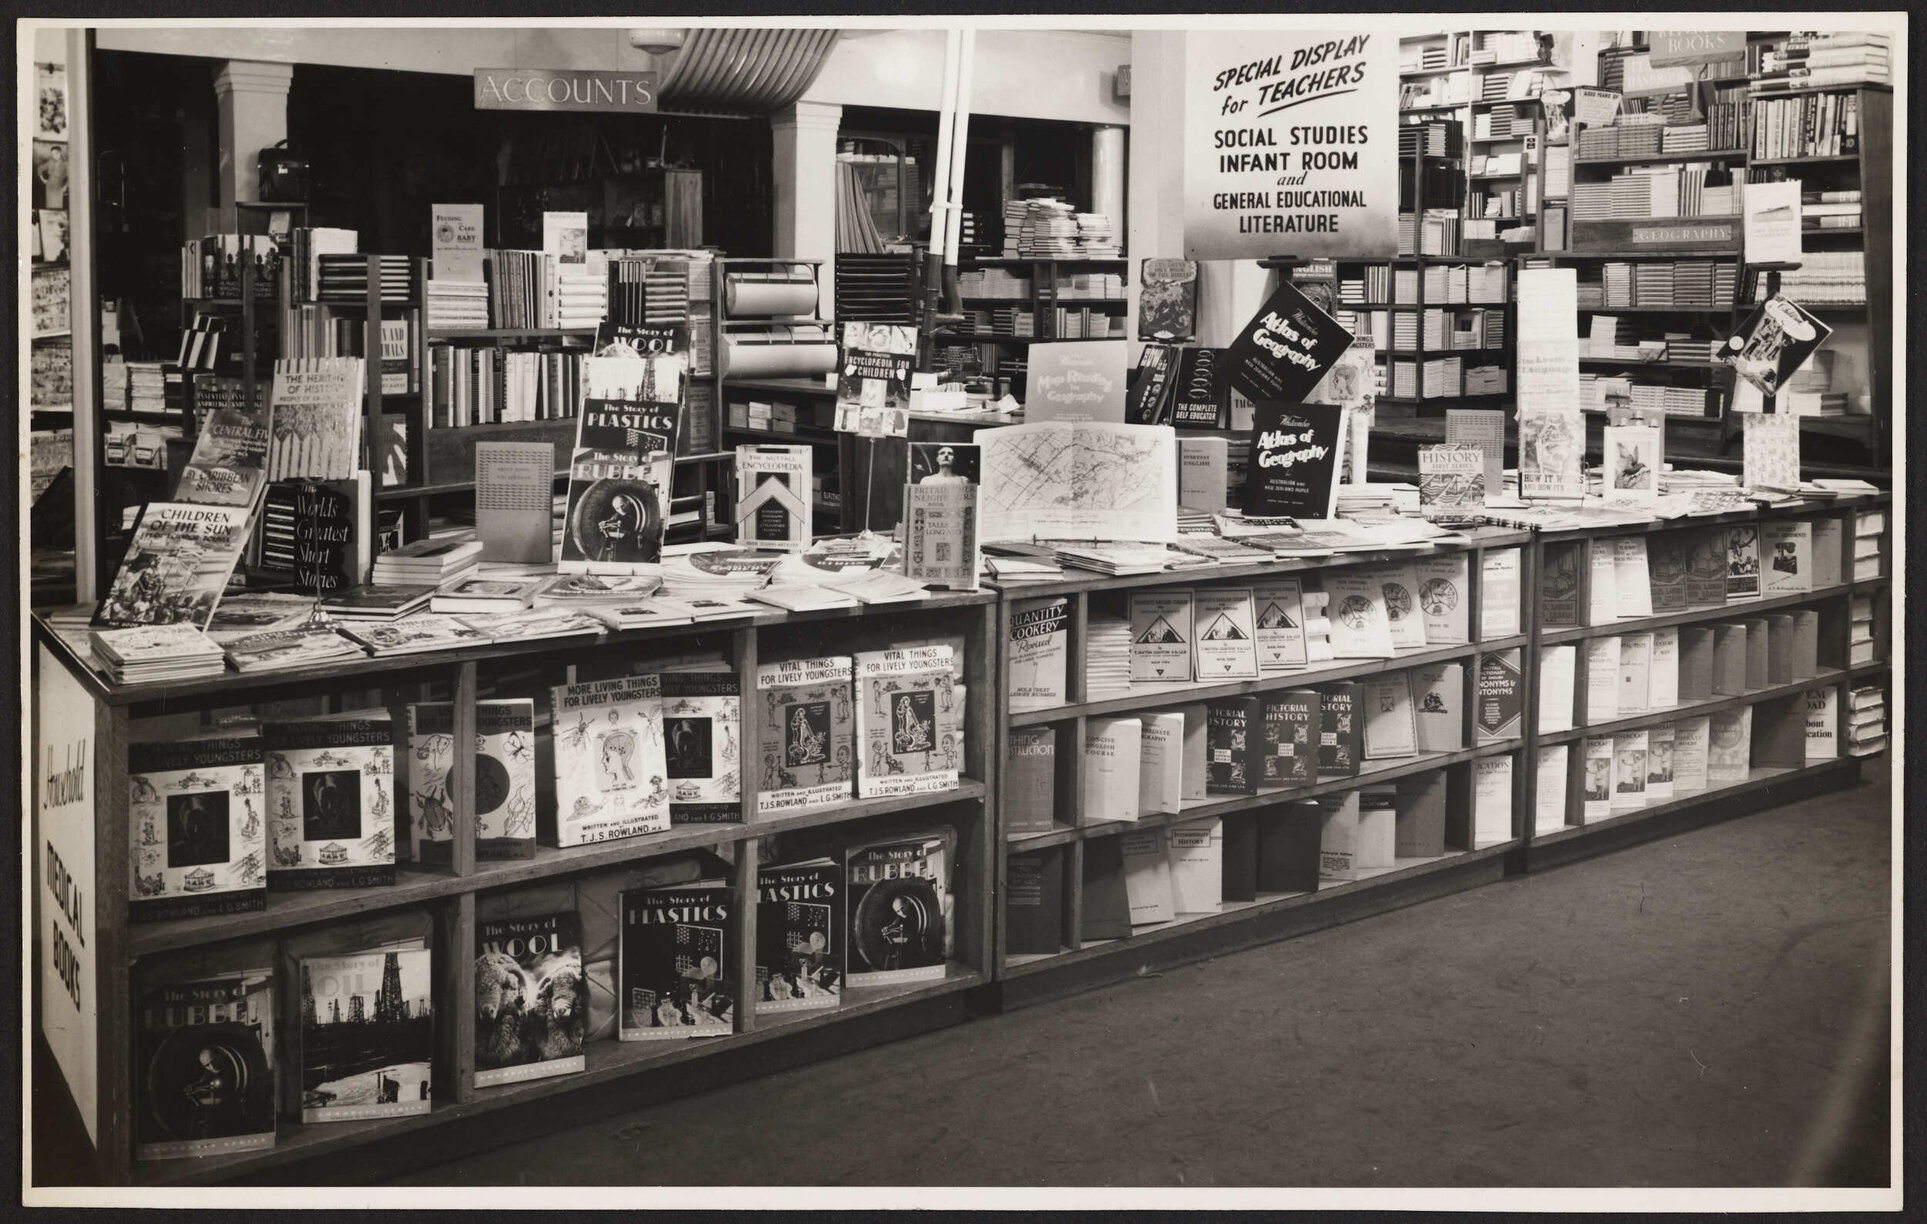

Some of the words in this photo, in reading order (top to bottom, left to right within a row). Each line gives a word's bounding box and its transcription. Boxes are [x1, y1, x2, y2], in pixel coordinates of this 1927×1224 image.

[1668, 33, 1726, 54] BOOKS
[1213, 55, 1282, 91] SPECIAL
[1290, 34, 1370, 71] DISPLAY
[479, 76, 651, 108] ACCOUNTS
[1221, 95, 1248, 116] for
[1258, 62, 1366, 105] TEACHERS
[1214, 128, 1277, 149] SOCIAL
[1290, 125, 1368, 145] STUDIES
[1220, 153, 1290, 173] INFANT
[1302, 151, 1358, 171] ROOM
[1277, 171, 1308, 186] and
[1213, 192, 1271, 210] GENERAL
[1277, 190, 1367, 208] EDUCATIONAL
[1240, 214, 1339, 233] LITERATURE
[1639, 228, 1728, 241] GEOGRAPHY
[618, 326, 633, 334] The
[636, 327, 659, 336] Story
[663, 329, 674, 337] of
[1260, 311, 1301, 343] Atlas
[1301, 337, 1318, 351] of
[613, 336, 674, 353] WOOL
[1252, 328, 1322, 372] Geography
[897, 360, 910, 370] FOR
[286, 375, 302, 384] THE
[857, 367, 895, 379] CHILDREN
[288, 385, 300, 394] OF
[623, 405, 646, 413] Story
[650, 405, 659, 413] of
[1177, 403, 1188, 411] THE
[1189, 404, 1217, 412] COMPLETE
[587, 412, 673, 430] PLASTICS
[1175, 411, 1188, 420] SELF
[1189, 412, 1217, 420] EDUCATOR
[213, 425, 253, 438] CENTRAL
[255, 429, 268, 439] FIV
[1257, 431, 1297, 449] Atlas
[1299, 429, 1315, 443] of
[614, 454, 638, 463] Story
[642, 454, 653, 463] of
[1258, 446, 1329, 468] Geography
[1422, 452, 1480, 463] HISTORY
[201, 469, 251, 482] CARIBBEAN
[1524, 474, 1541, 482] HOW
[1544, 474, 1554, 483] IT
[195, 481, 234, 494] SHORES
[161, 509, 231, 523] CHILDREN
[150, 520, 171, 531] OF
[174, 521, 199, 533] THE
[203, 523, 233, 535] SUN
[296, 519, 348, 542] Greatest
[296, 542, 330, 564] Short
[296, 567, 338, 589] Stories
[1010, 620, 1060, 641] COOKERY
[1016, 634, 1053, 653] Revised
[884, 651, 905, 661] VITAL
[909, 649, 937, 659] THINGS
[779, 661, 802, 672] VITAL
[805, 659, 835, 669] THINGS
[866, 663, 881, 673] FOR
[883, 661, 906, 671] LIVELY
[909, 658, 954, 669] YOUNGSTERS
[761, 674, 776, 685] FOR
[778, 672, 802, 683] LIVELY
[805, 668, 852, 681] YOUNGSTERS
[567, 684, 592, 696] MORE
[594, 680, 623, 693] LIVING
[626, 676, 658, 689] THINGS
[684, 682, 738, 694] YOUNGSTERS
[1479, 680, 1509, 688] NONYMS
[1479, 687, 1513, 695] NTONYMS
[564, 697, 580, 708] FOR
[582, 692, 608, 705] LIVELY
[610, 687, 662, 702] YOUNGSTERS
[1266, 703, 1309, 713] PICTORIAL
[1321, 702, 1352, 711] STORY
[476, 716, 532, 728] OUNGSTERS
[1265, 713, 1310, 721] HISTORY
[1806, 720, 1824, 728] bout
[327, 731, 391, 745] YOUNGSTERS
[1086, 736, 1115, 744] CONCISE
[1806, 730, 1833, 738] cation
[194, 749, 262, 764] YOUNGSTERS
[915, 773, 948, 781] ILLUSTRATED
[808, 785, 842, 794] ILLUSTRATED
[884, 784, 915, 794] ROWLAND
[939, 780, 959, 788] SMITH
[776, 797, 808, 808] ROWLAND
[832, 792, 852, 801] SMITH
[582, 822, 608, 831] WRITTEN
[622, 814, 659, 825] ILLUSTRATED
[716, 812, 740, 821] SMITH
[608, 825, 649, 839] ROWLAND
[888, 851, 913, 859] Story
[917, 847, 927, 857] of
[780, 874, 805, 883] Story
[808, 872, 819, 880] of
[46, 839, 85, 949] MEDICAL
[647, 897, 663, 905] The
[669, 896, 695, 904] Story
[629, 904, 727, 924] PLASTICS
[485, 926, 504, 936] The
[509, 923, 539, 932] Story
[544, 918, 556, 929] of
[482, 933, 558, 957] WOOL
[53, 918, 81, 1013] BOOKS
[310, 961, 333, 971] The
[335, 959, 366, 971] Story
[367, 957, 381, 969] of
[191, 988, 226, 999] Story
[232, 984, 247, 997] of
[315, 974, 374, 998] OIL
